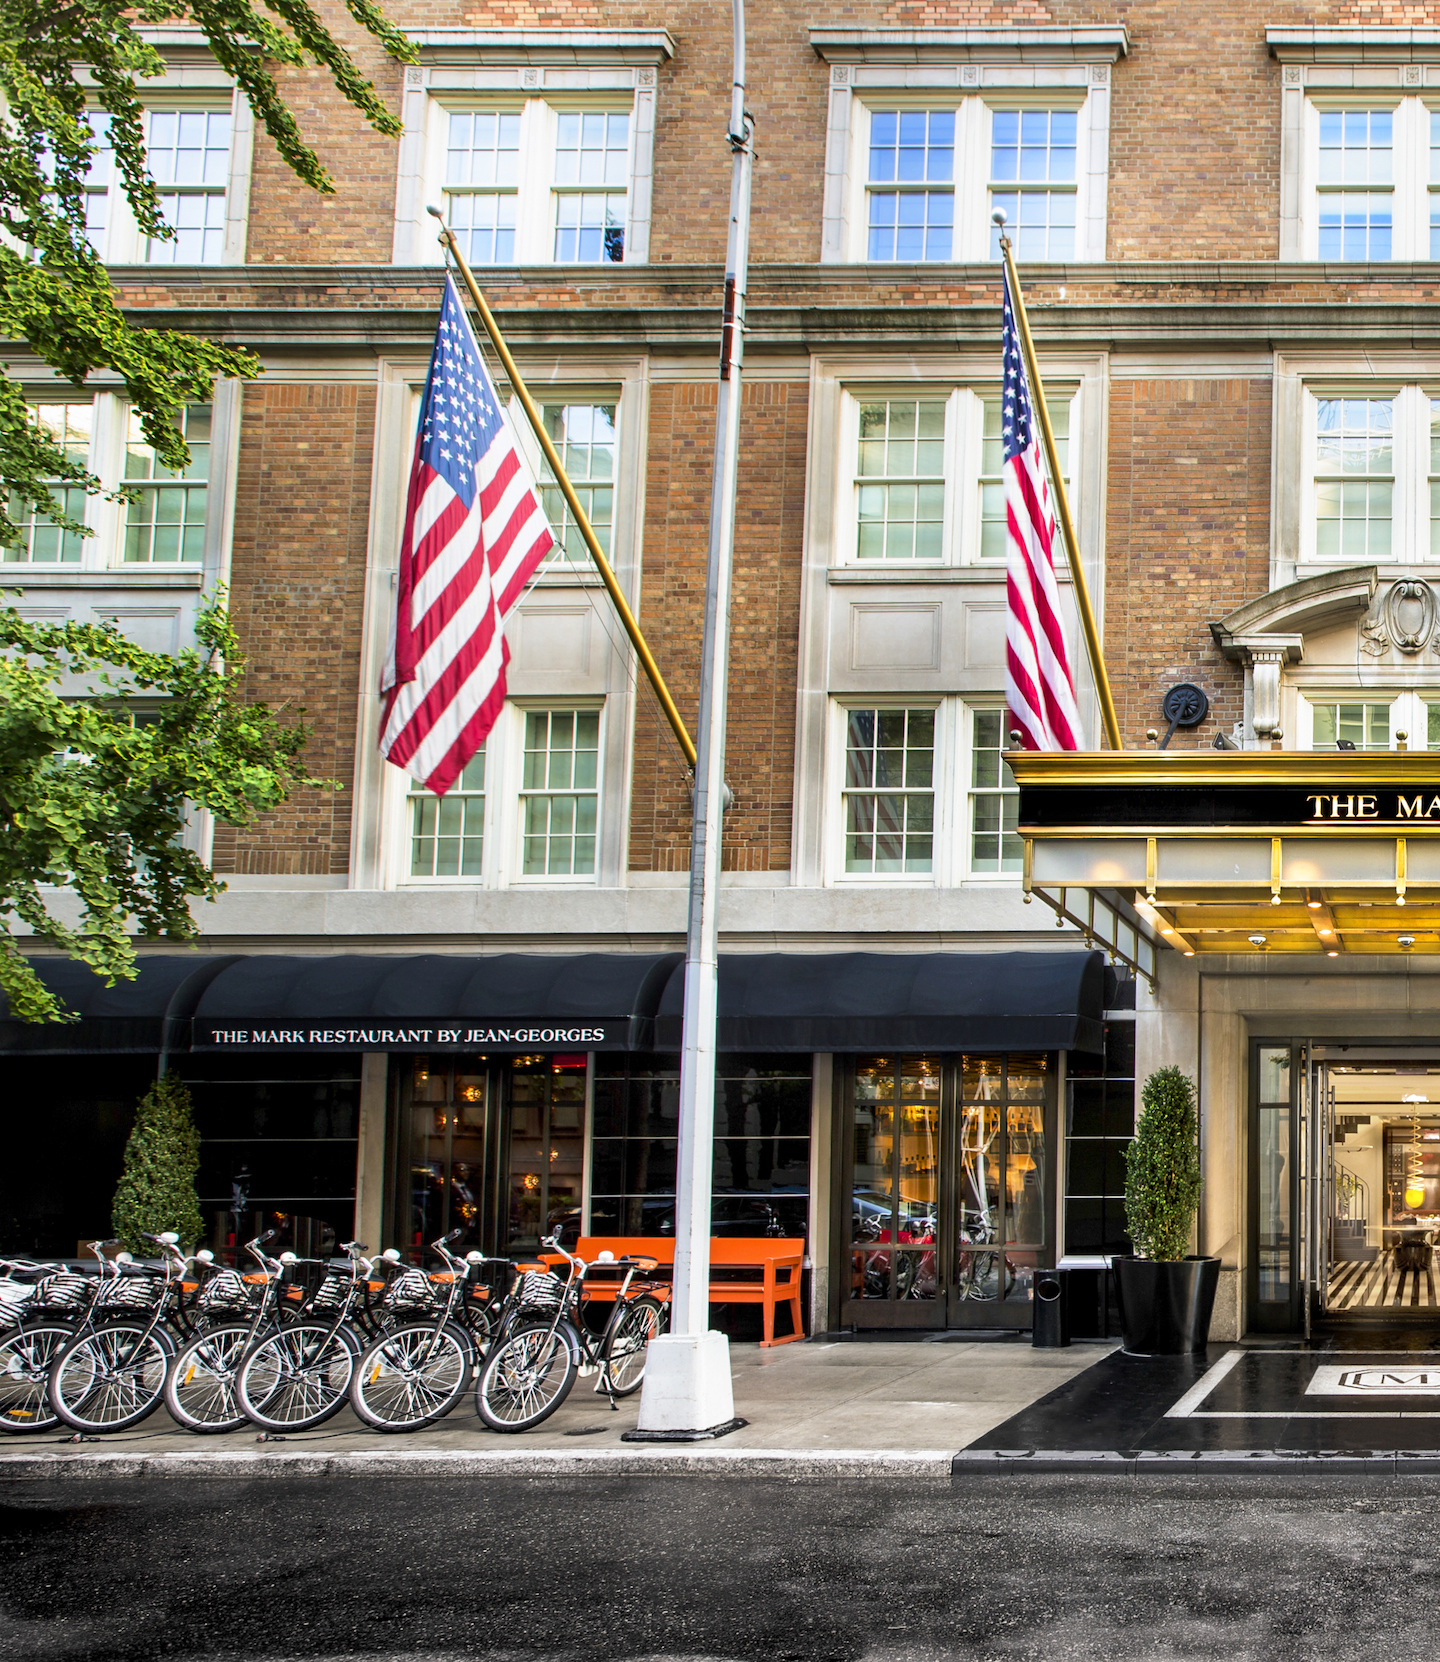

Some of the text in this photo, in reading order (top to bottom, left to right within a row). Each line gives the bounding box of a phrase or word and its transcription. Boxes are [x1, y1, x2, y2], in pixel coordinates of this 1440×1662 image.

[1306, 795, 1379, 818] THE
[211, 1028, 605, 1043] THE MARK RESTAURANT BY JEAN-GEORGES
